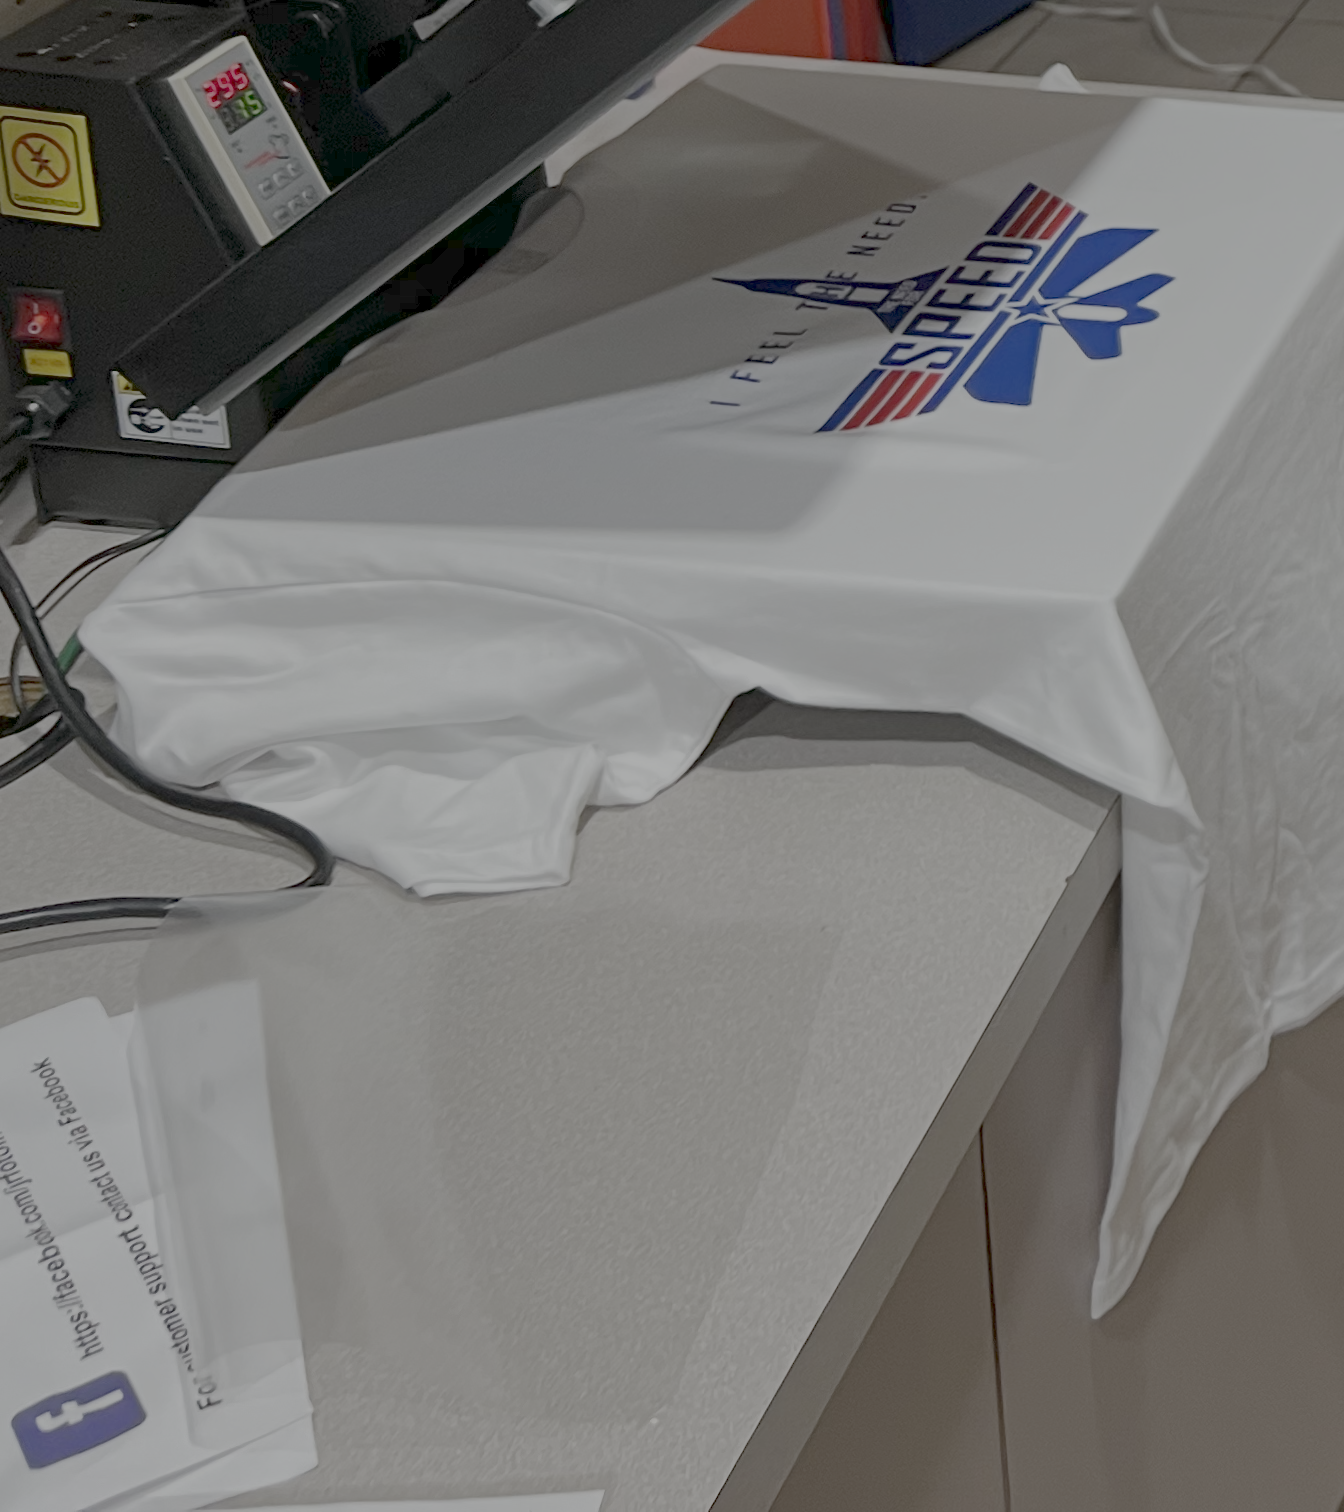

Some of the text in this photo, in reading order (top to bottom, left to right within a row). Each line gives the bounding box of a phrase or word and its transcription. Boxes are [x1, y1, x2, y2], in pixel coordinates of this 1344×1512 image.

[203, 62, 250, 109] 295
[878, 240, 1042, 369] SPEED
[709, 399, 741, 407] I
[729, 328, 808, 383] FEEL
[795, 270, 858, 310] THE
[30, 1056, 82, 1127] Facebook
[67, 1124, 94, 1151] via
[83, 1150, 106, 1173] us
[90, 1171, 133, 1223] contact
[117, 1224, 167, 1295] support
[193, 1372, 223, 1410] For
